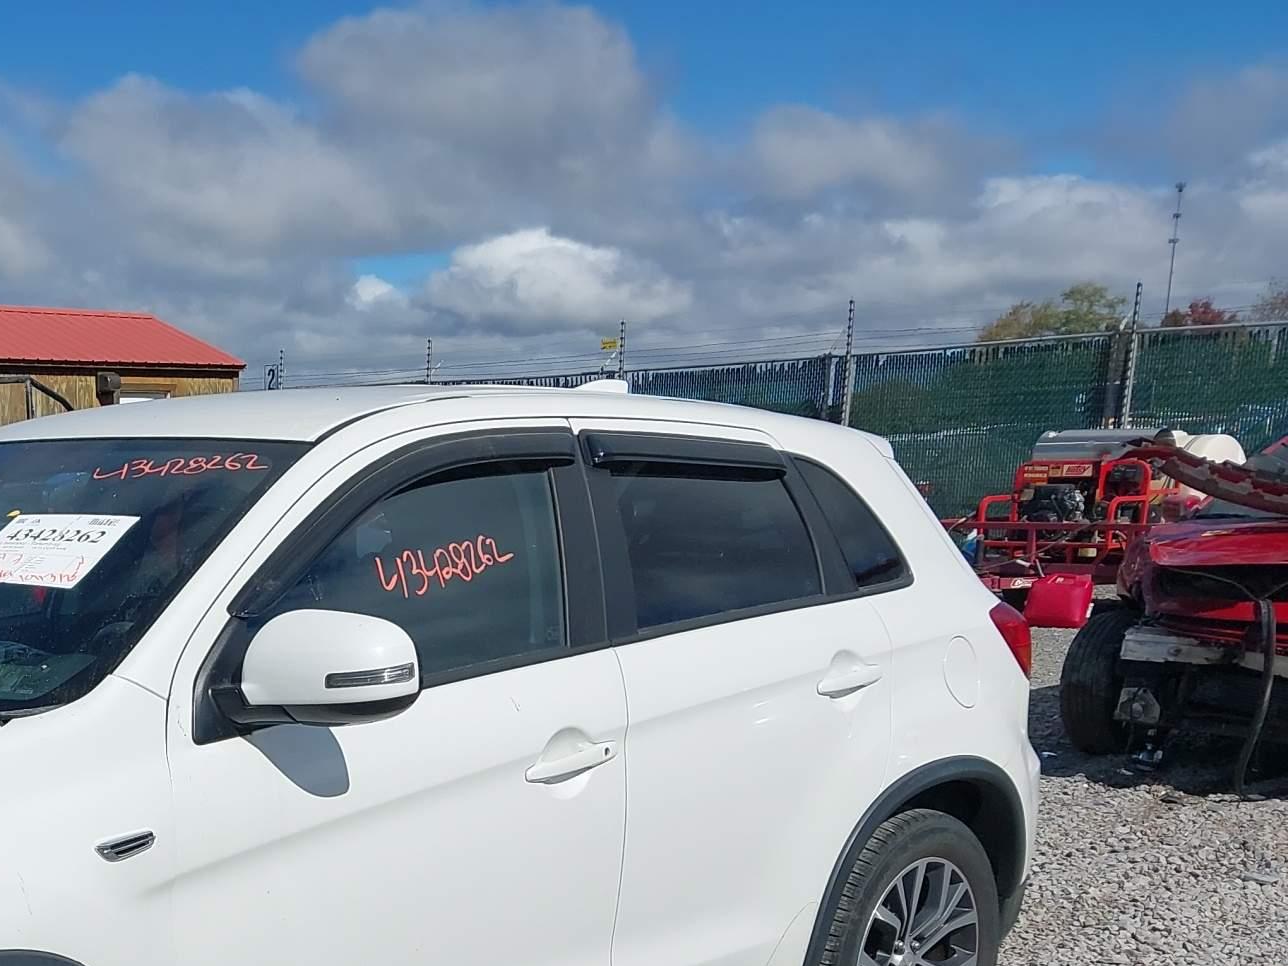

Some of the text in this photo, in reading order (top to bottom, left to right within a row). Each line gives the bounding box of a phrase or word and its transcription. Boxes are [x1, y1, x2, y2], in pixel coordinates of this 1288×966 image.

[93, 453, 268, 480] 43428262
[6, 528, 106, 544] 43428262
[374, 534, 514, 598] 43428262
